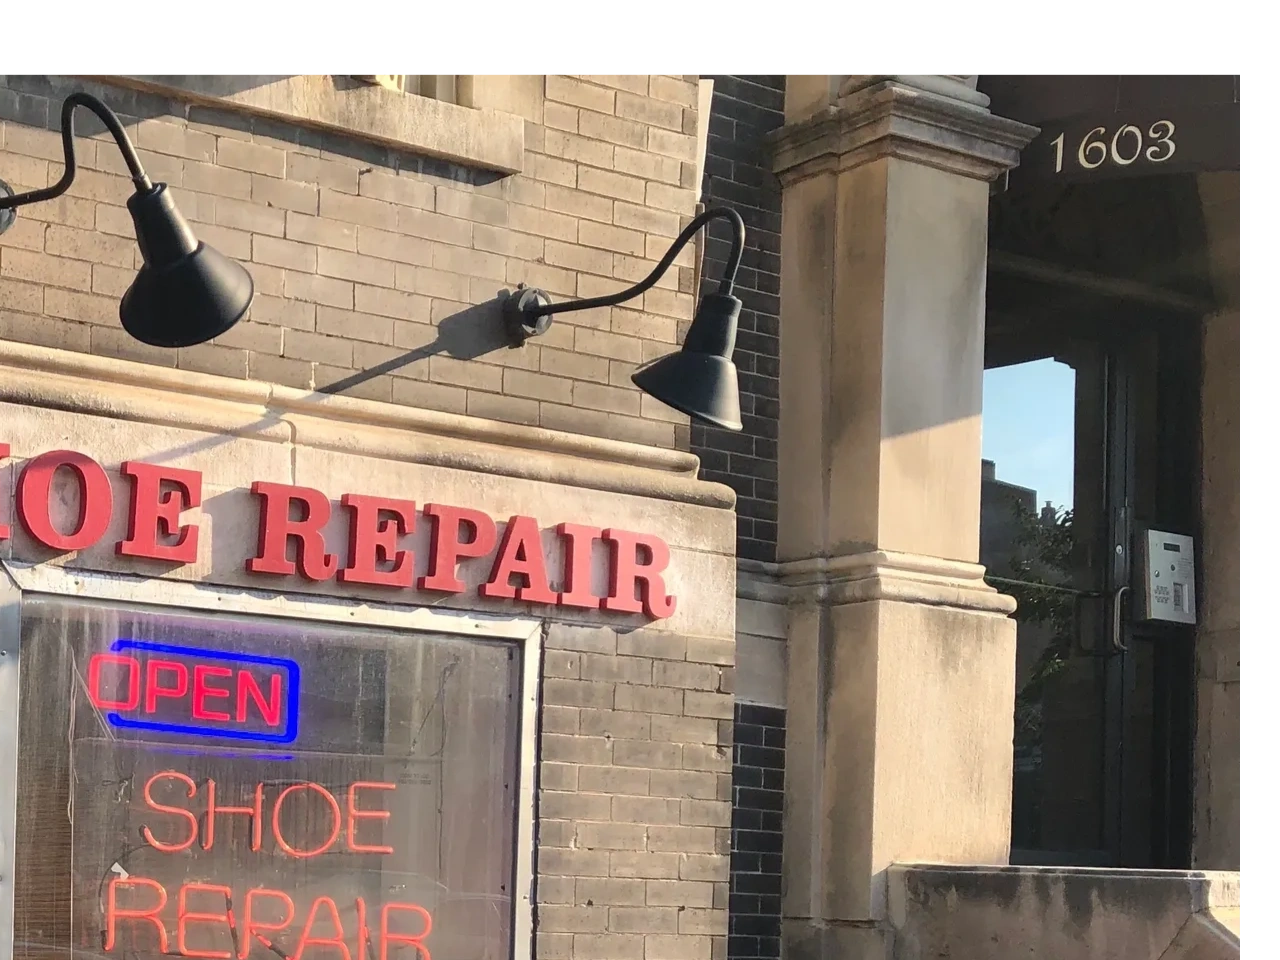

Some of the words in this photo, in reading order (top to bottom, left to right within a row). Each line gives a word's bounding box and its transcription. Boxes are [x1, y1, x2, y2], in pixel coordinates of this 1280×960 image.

[1050, 119, 1177, 173] 1603
[245, 480, 677, 620] REPAIR
[89, 653, 282, 727] OPEN
[141, 770, 396, 858] SHOE
